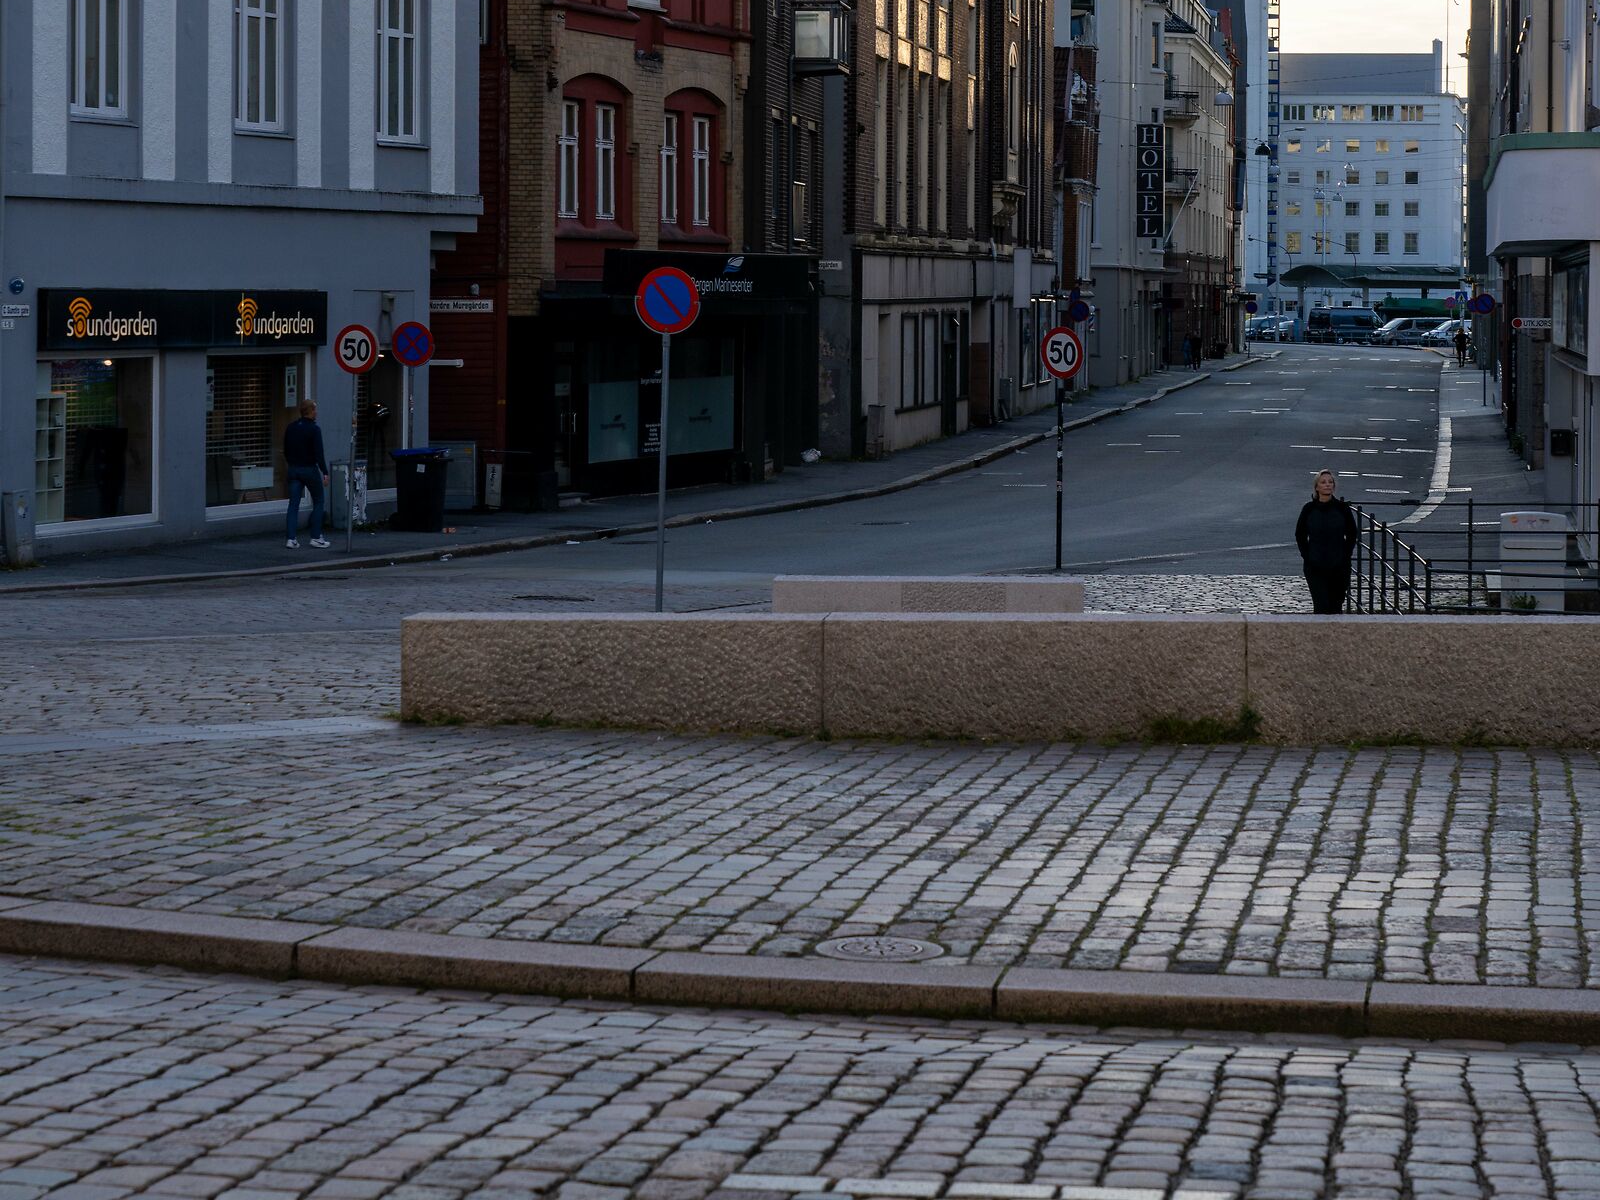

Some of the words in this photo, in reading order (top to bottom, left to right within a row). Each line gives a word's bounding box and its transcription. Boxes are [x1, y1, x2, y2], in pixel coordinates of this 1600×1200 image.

[1141, 126, 1159, 236] HOTEL
[714, 277, 754, 293] Marinesenter
[66, 310, 157, 342] soundgarden
[235, 310, 314, 340] soundgarden
[343, 338, 370, 362] 50
[1049, 340, 1076, 366] 50
